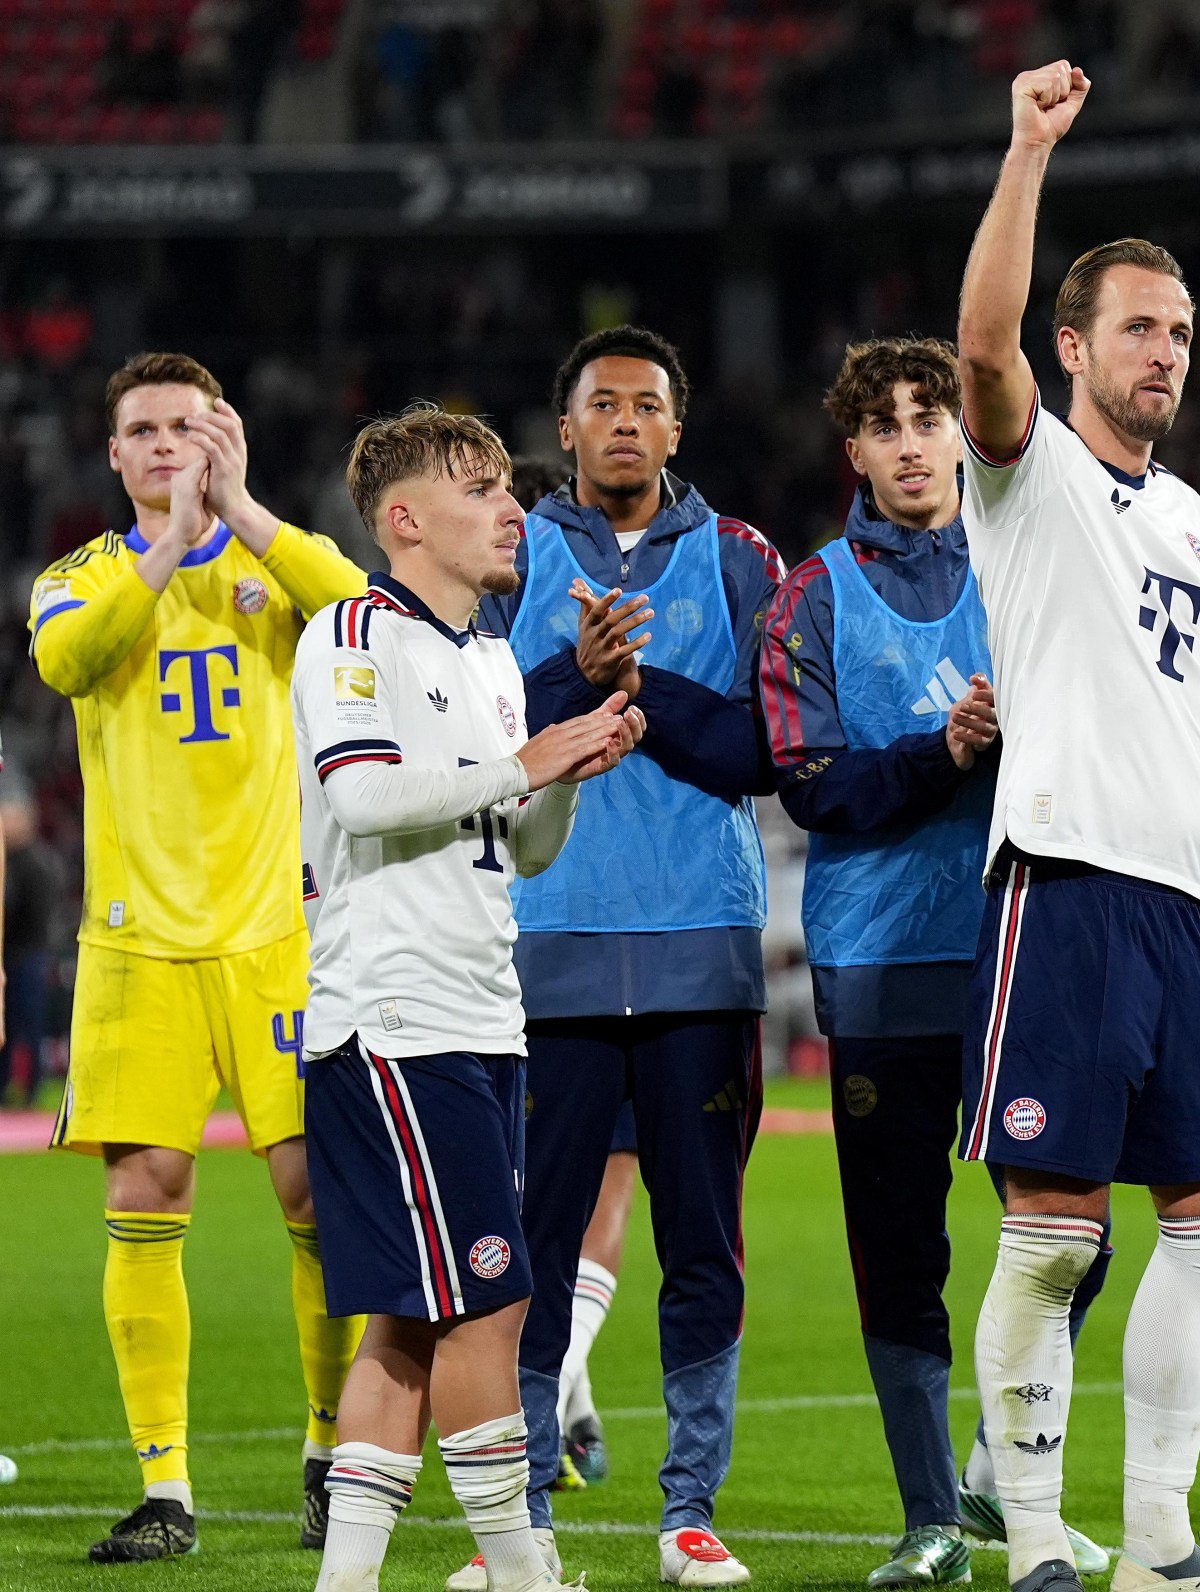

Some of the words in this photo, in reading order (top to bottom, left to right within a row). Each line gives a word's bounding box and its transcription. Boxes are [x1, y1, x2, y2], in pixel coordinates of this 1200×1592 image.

[159, 644, 241, 744] T
[1010, 1103, 1018, 1112] FC
[1018, 1100, 1044, 1117] BAYERN
[477, 1238, 505, 1249] BAYERN
